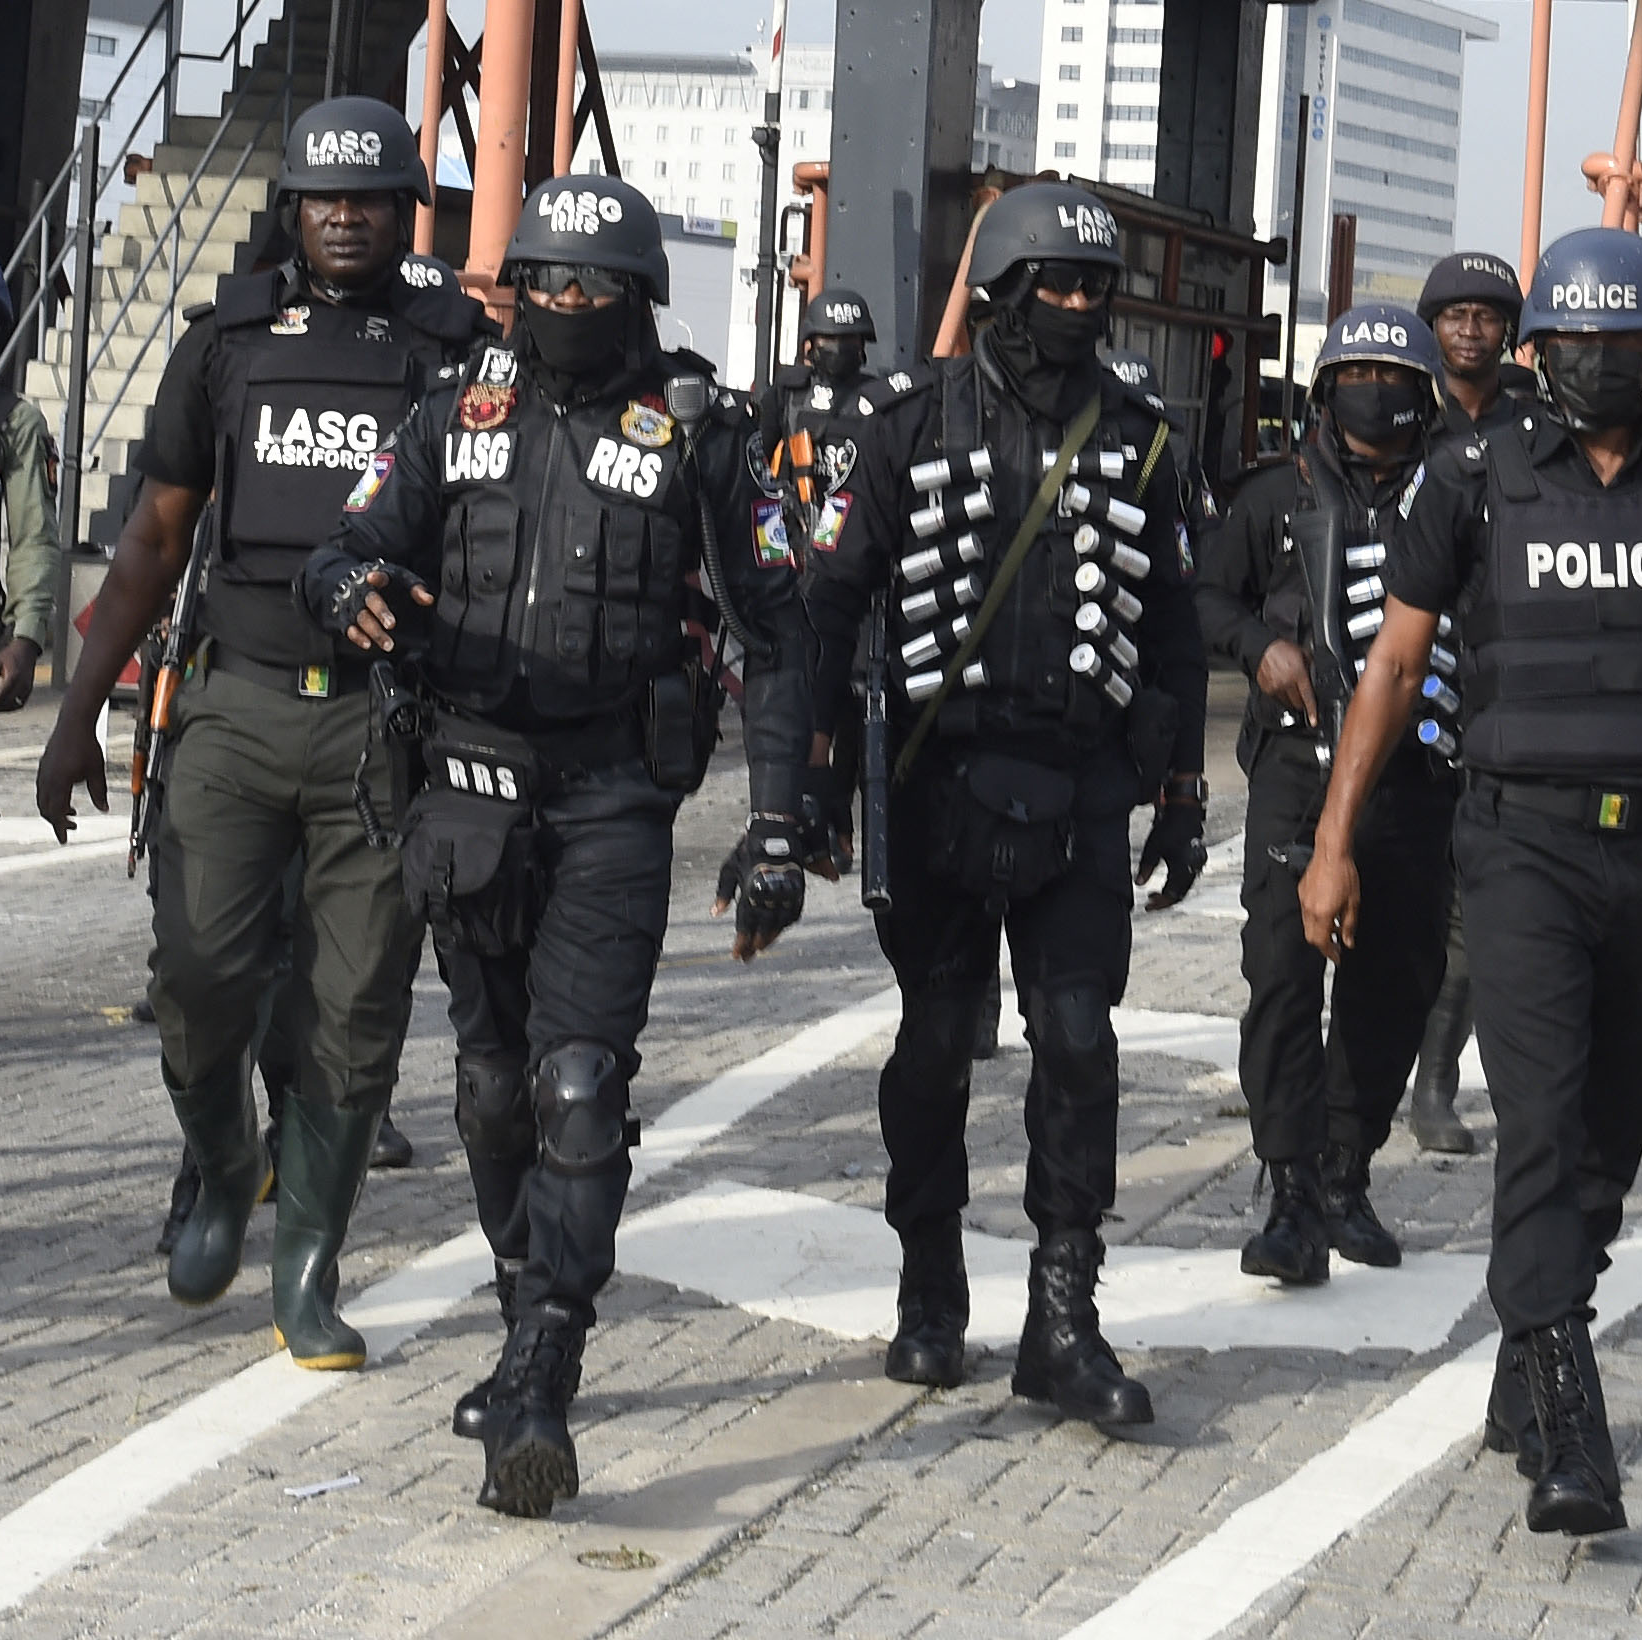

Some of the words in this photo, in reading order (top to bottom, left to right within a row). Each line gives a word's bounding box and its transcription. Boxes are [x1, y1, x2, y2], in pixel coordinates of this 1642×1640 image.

[306, 130, 383, 158] LASG
[338, 153, 381, 167] FORCE
[538, 190, 623, 223] LASG
[1462, 257, 1516, 287] POLICE
[1552, 283, 1638, 310] POLICE
[1341, 321, 1408, 348] LASG
[258, 404, 378, 452] LASG
[445, 431, 511, 482] LASG
[586, 437, 663, 498] RRS
[446, 756, 518, 800] RRS
